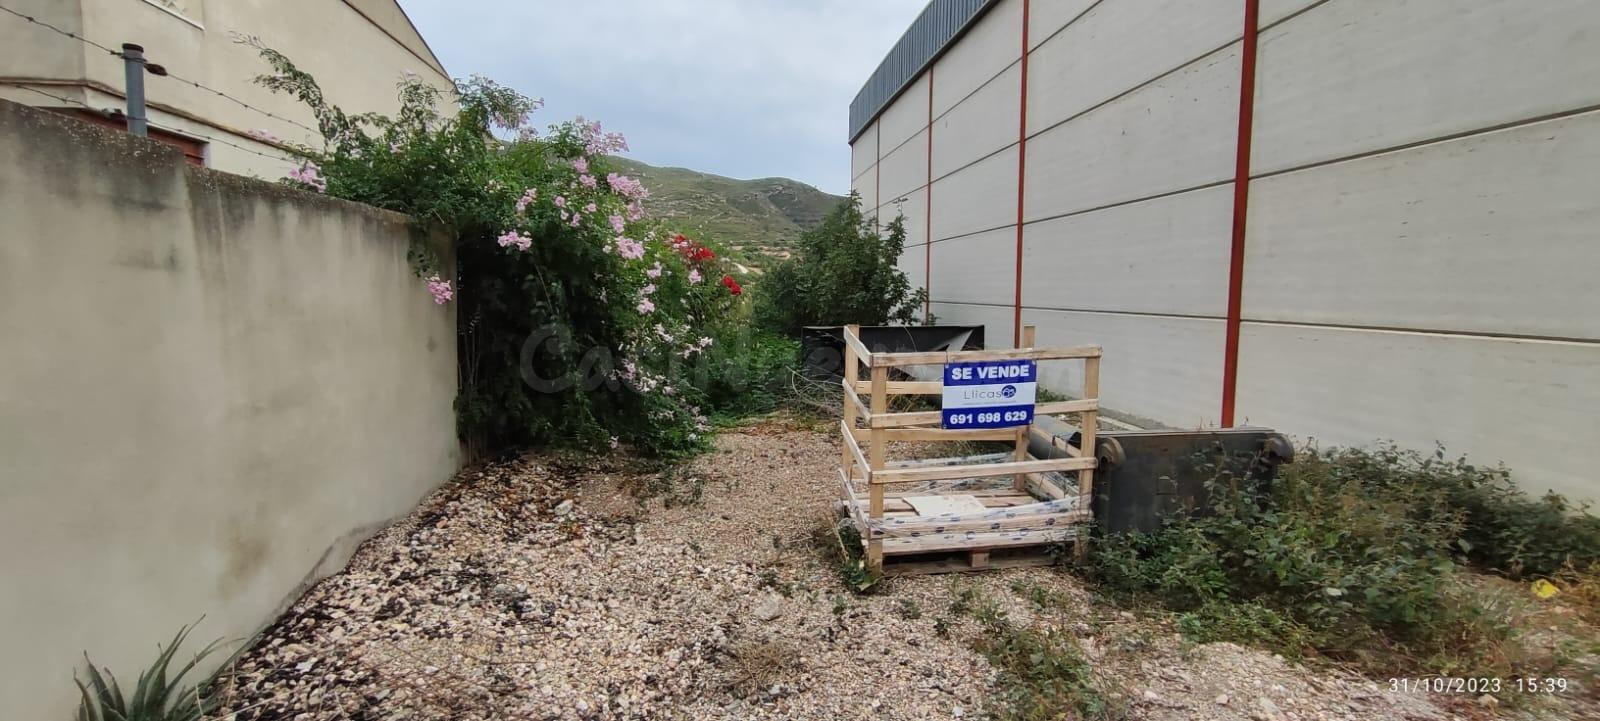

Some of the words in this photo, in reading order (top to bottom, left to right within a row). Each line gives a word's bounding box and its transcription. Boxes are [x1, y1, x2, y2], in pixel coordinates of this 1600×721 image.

[951, 367, 972, 380] SE
[977, 364, 1030, 379] VENDE
[949, 413, 973, 425] 691
[977, 412, 1001, 423] 698
[1004, 410, 1027, 422] 629
